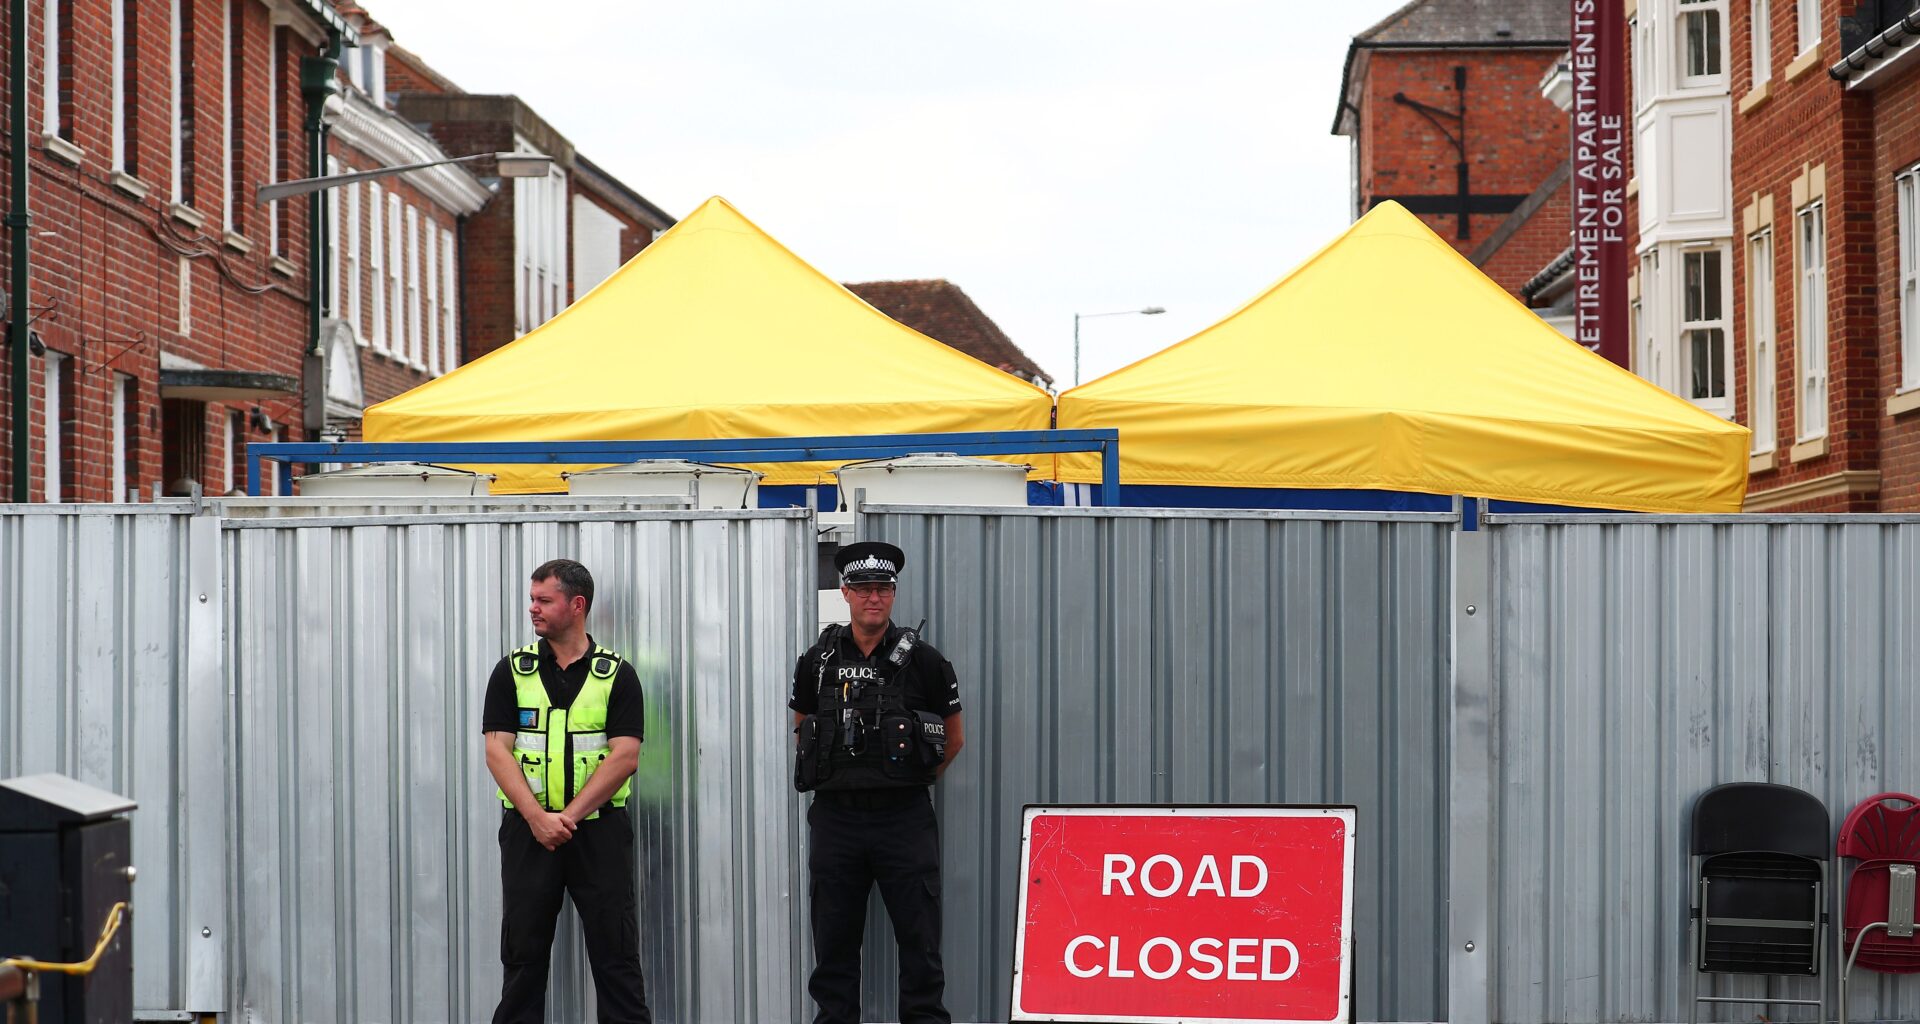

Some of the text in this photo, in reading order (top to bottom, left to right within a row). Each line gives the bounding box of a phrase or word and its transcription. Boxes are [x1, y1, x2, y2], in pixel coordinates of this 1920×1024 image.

[1574, 0, 1597, 183] APARTMENTS
[1601, 114, 1623, 242] FOR SALE
[838, 666, 878, 680] POLICE
[924, 722, 945, 736] POLICE
[1102, 853, 1269, 898] ROAD
[1064, 935, 1300, 981] CLOSED
